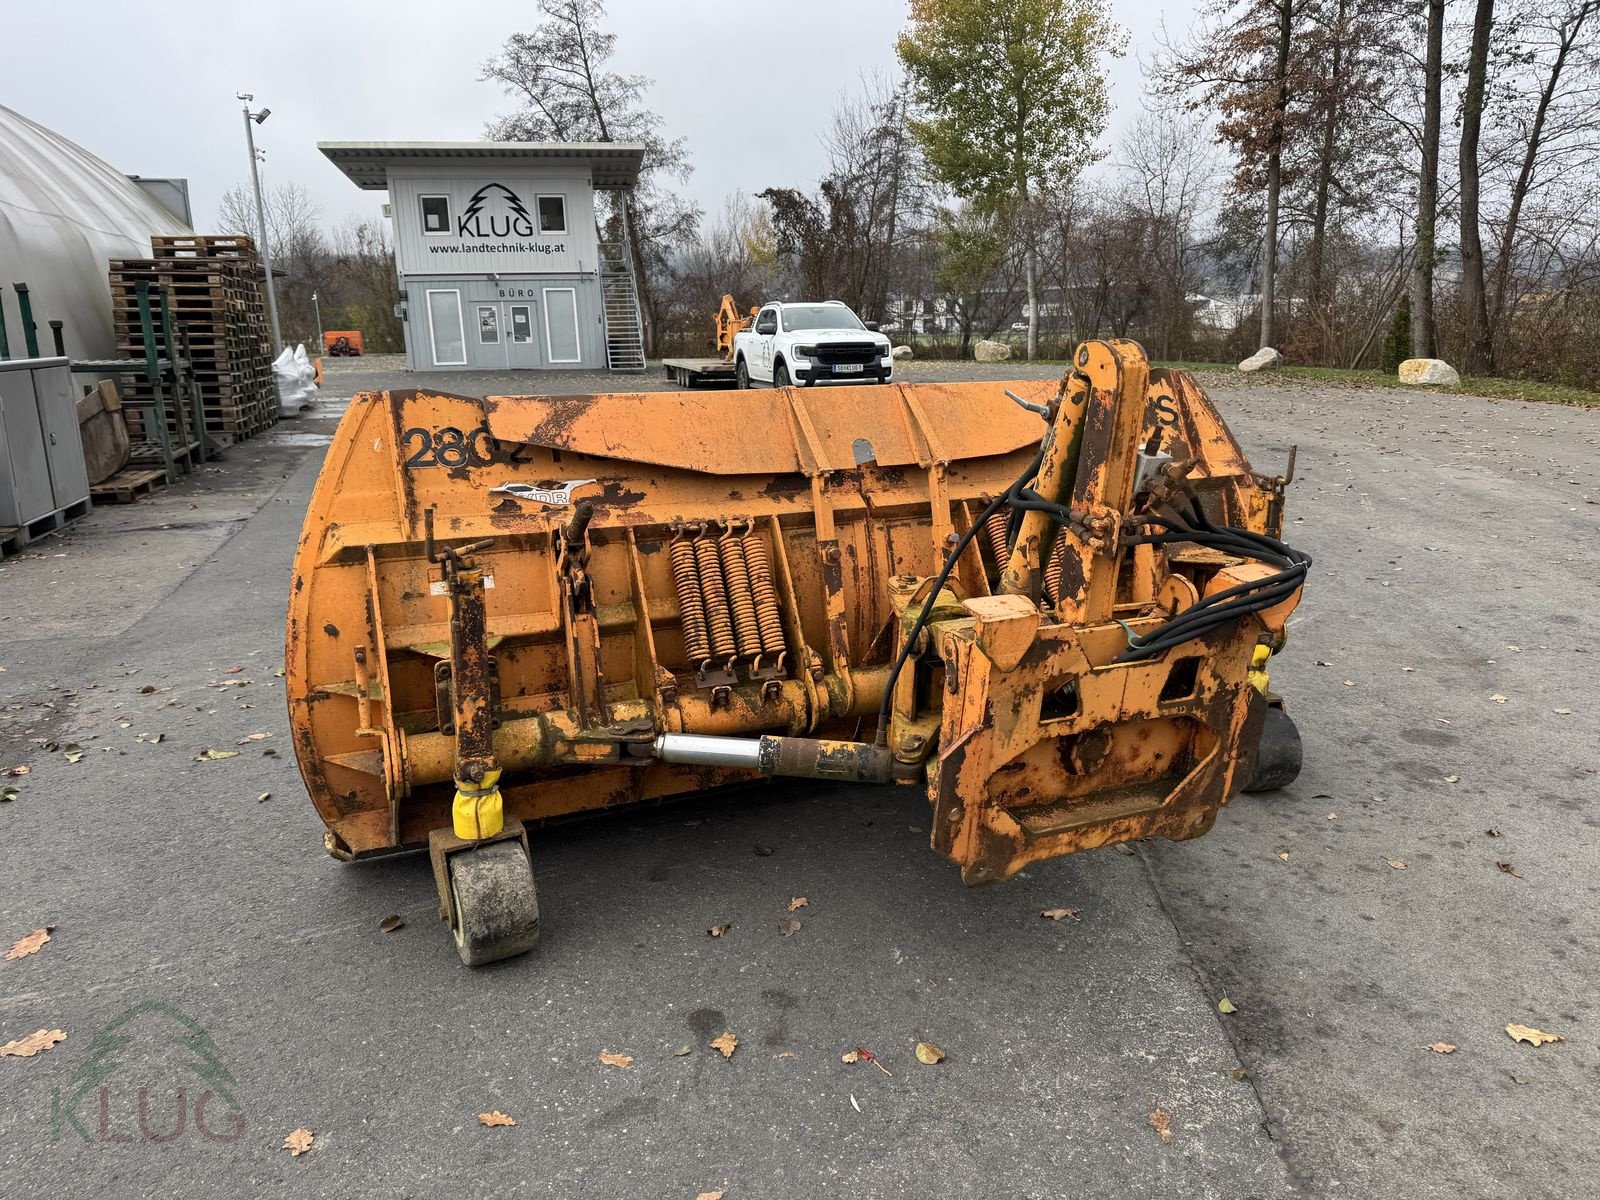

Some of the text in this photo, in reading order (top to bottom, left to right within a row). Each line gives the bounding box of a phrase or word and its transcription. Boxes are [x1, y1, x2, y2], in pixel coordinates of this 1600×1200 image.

[457, 215, 534, 238] KLUG
[429, 242, 565, 255] www.landtechnik-klug.at
[499, 288, 534, 298] BÜRO
